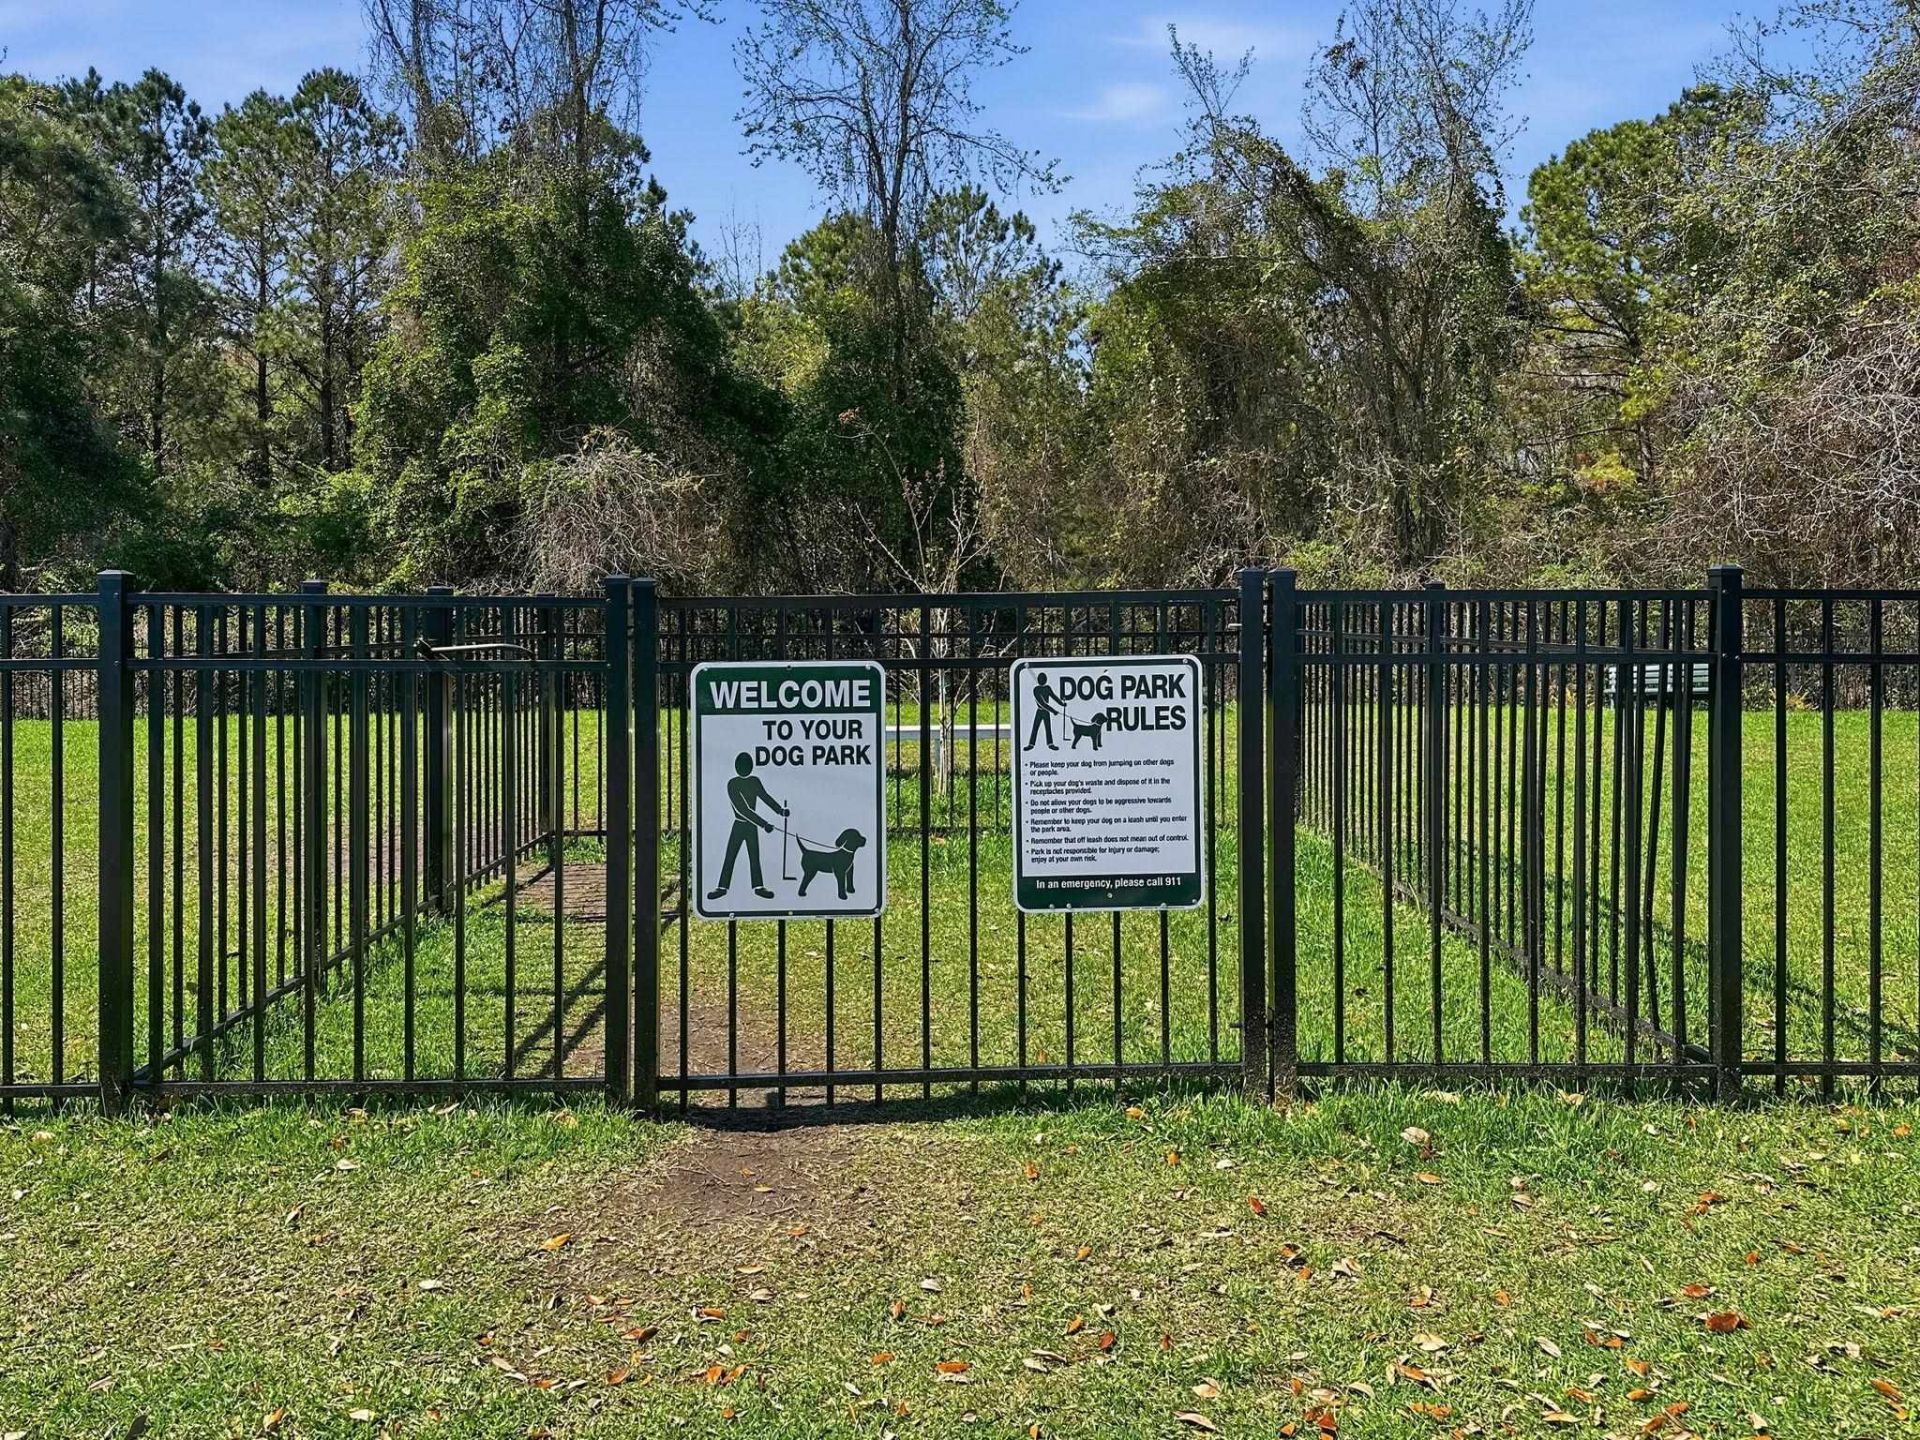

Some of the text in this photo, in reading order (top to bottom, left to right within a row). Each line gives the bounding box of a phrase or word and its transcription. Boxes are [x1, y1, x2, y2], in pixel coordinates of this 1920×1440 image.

[710, 680, 871, 709] WELCOME
[1060, 674, 1186, 700] DOG PARK
[1106, 705, 1186, 731] RULES
[762, 720, 862, 740] TO YOUR
[755, 744, 871, 766] DOG PARK
[1032, 856, 1047, 864] enjoy
[1036, 880, 1045, 889] In
[1061, 880, 1113, 889] emergency,
[1115, 878, 1145, 888] please
[1147, 877, 1163, 886] call
[1165, 877, 1181, 886] 911
